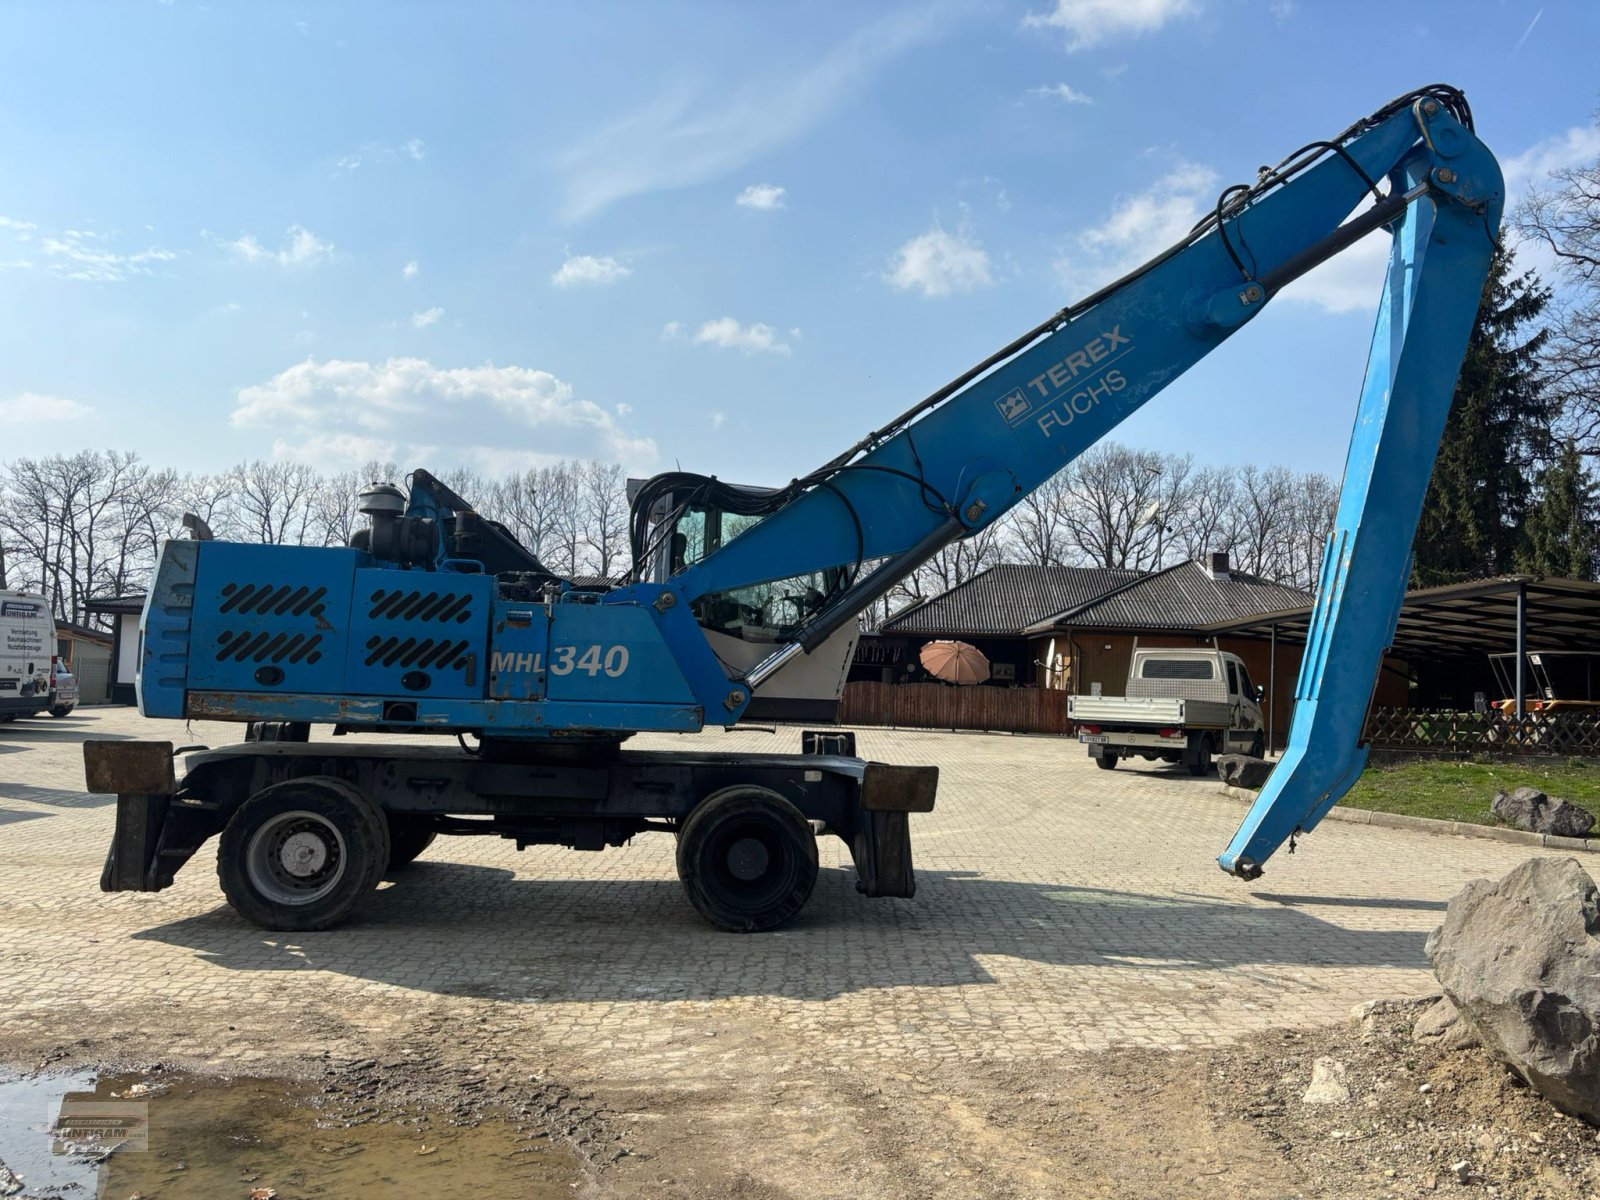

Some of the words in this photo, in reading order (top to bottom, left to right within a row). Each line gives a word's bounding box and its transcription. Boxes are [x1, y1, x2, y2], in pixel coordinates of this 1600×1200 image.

[1026, 324, 1131, 397] TEREX
[1036, 369, 1127, 438] FUCHS
[8, 644, 41, 652] Nutzfahrzeuge
[11, 628, 38, 637] Vermietung
[490, 652, 546, 673] MHL
[550, 645, 629, 678] 340
